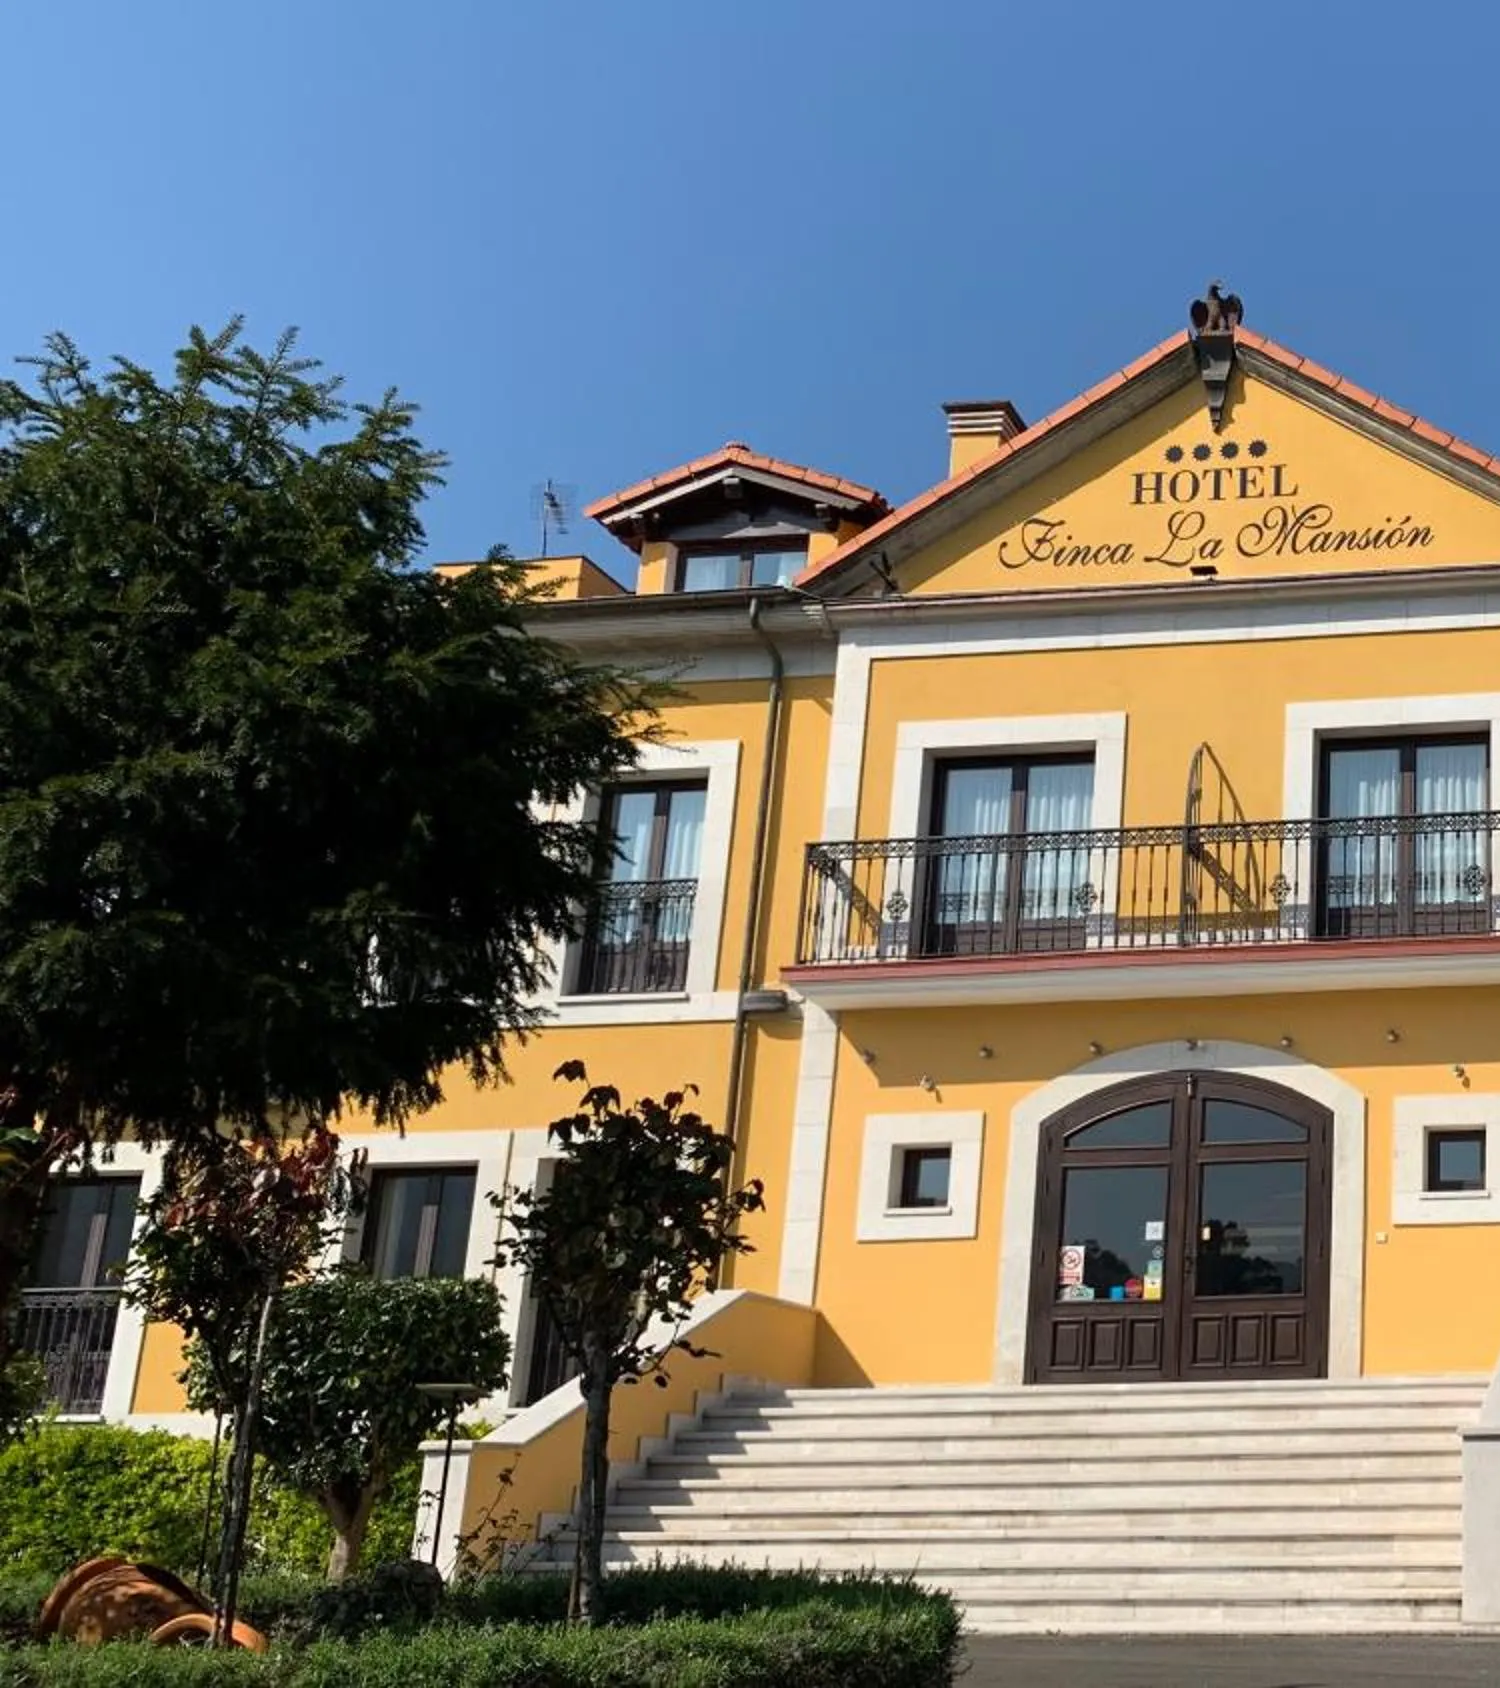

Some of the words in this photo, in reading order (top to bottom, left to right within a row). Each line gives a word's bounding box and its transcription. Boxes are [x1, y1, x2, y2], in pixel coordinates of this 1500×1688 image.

[1131, 464, 1298, 504] HOTEL
[999, 517, 1135, 569] Finca
[1143, 510, 1225, 566] La
[1236, 503, 1435, 558] Mansión
